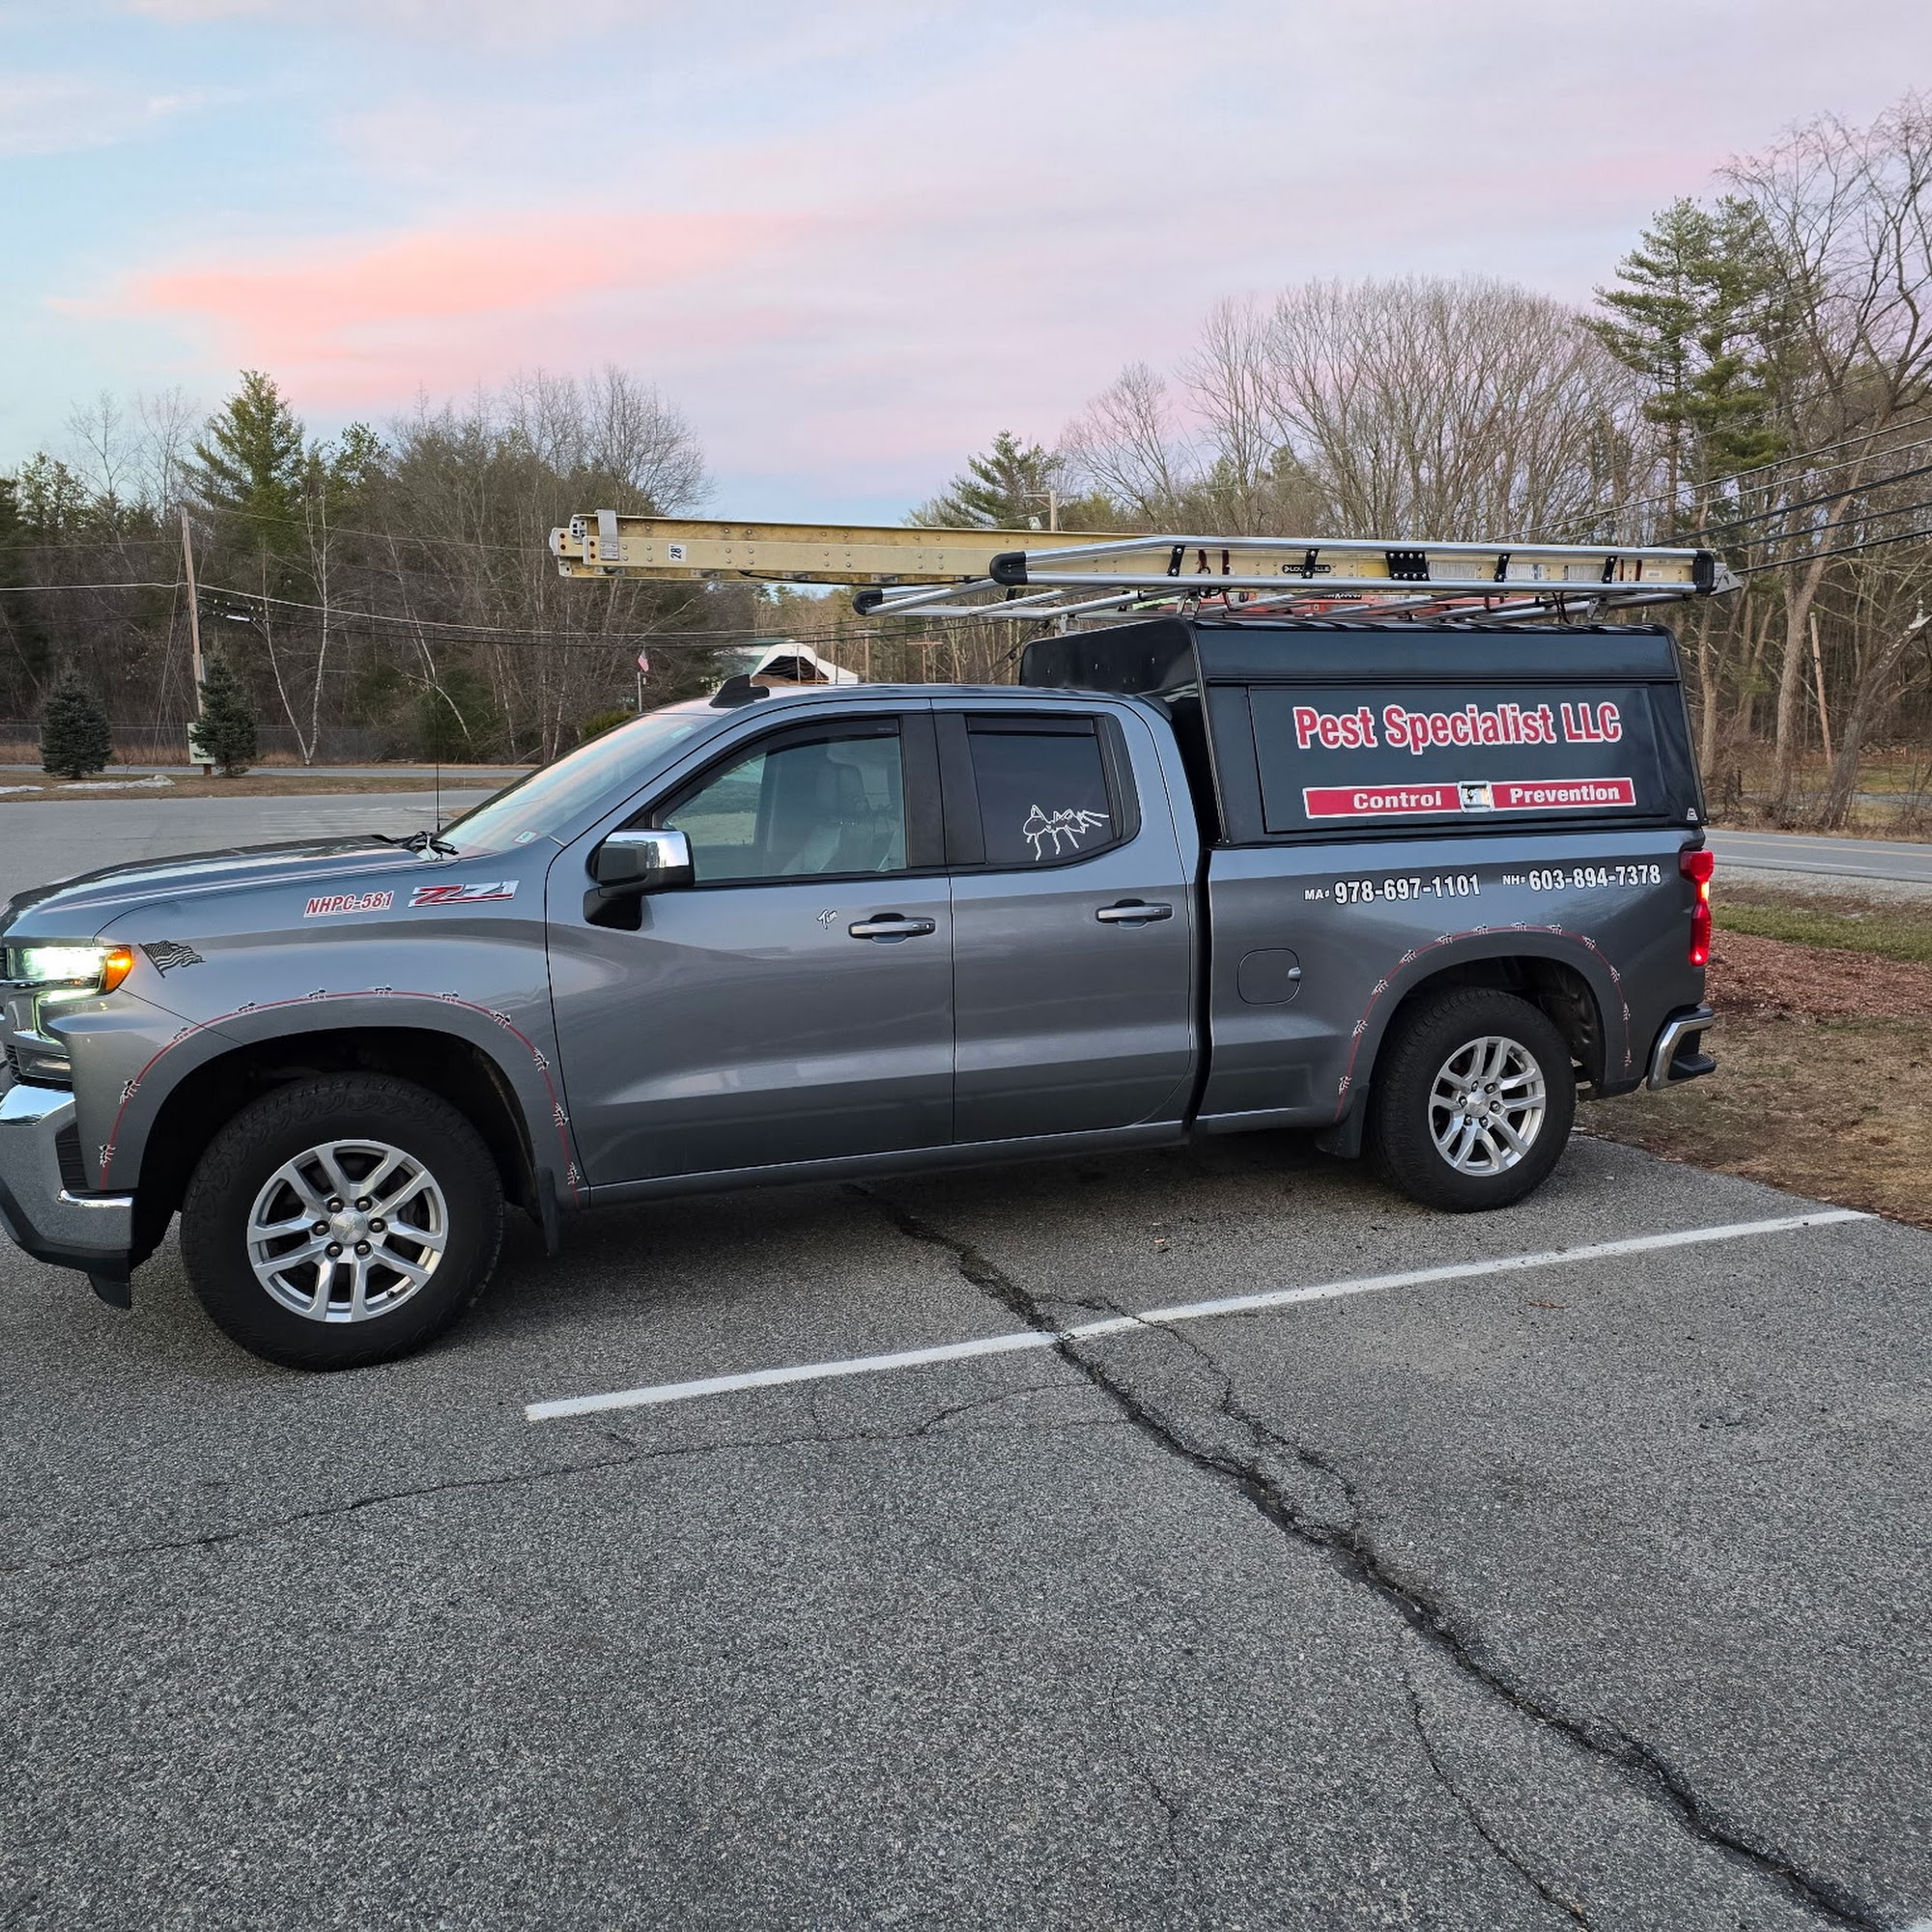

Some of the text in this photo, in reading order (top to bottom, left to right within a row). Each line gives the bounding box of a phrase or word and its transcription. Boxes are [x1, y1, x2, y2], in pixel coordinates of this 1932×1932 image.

[1293, 702, 1622, 754] Pest Specialist LLC
[1353, 785, 1620, 810] Control Prevention
[1334, 874, 1480, 904] 978-697-1101
[1528, 865, 1662, 891] 603-894-7378
[305, 892, 393, 914] NHPC-581
[408, 880, 520, 907] Z71
